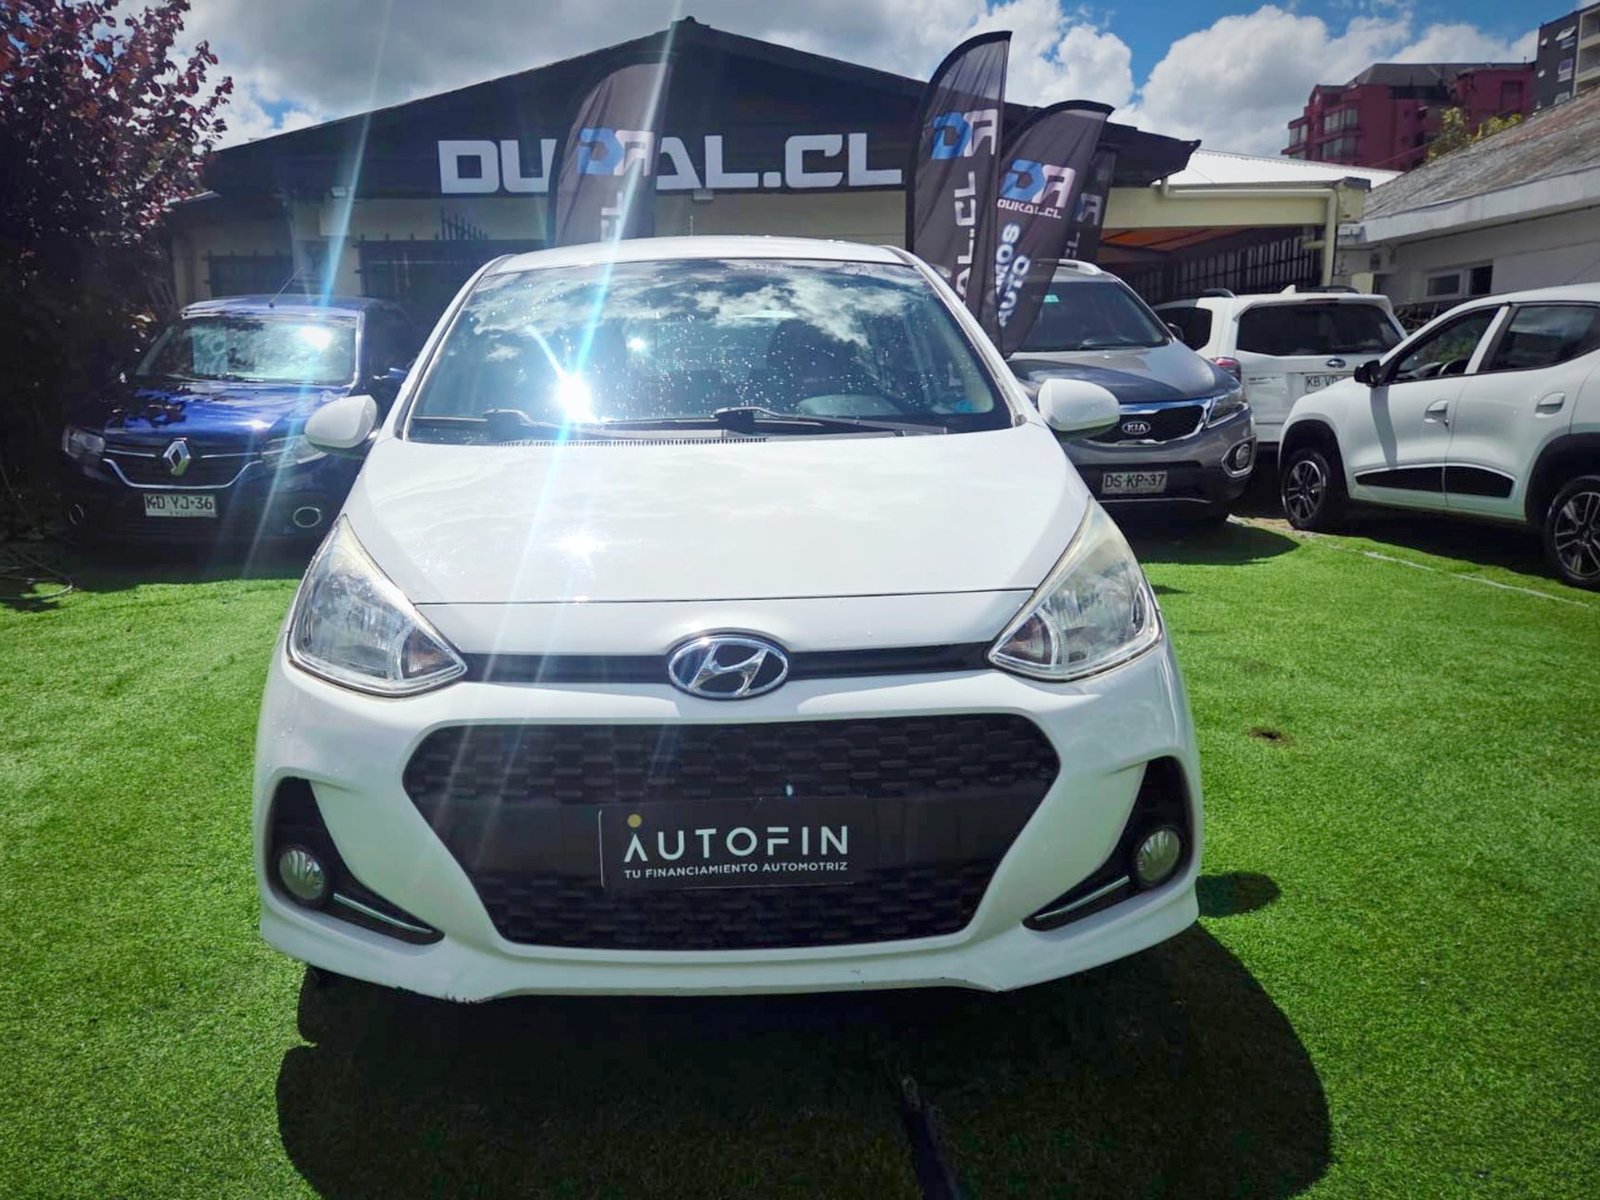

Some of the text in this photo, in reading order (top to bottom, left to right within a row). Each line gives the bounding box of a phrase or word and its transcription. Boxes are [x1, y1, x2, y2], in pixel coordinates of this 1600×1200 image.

[438, 133, 902, 193] DUAL.CL
[1127, 423, 1147, 432] KIA
[624, 825, 848, 863] AUTOFIN
[624, 861, 848, 879] TU FINANCIAMIENTO AUTOMOTRIZ
